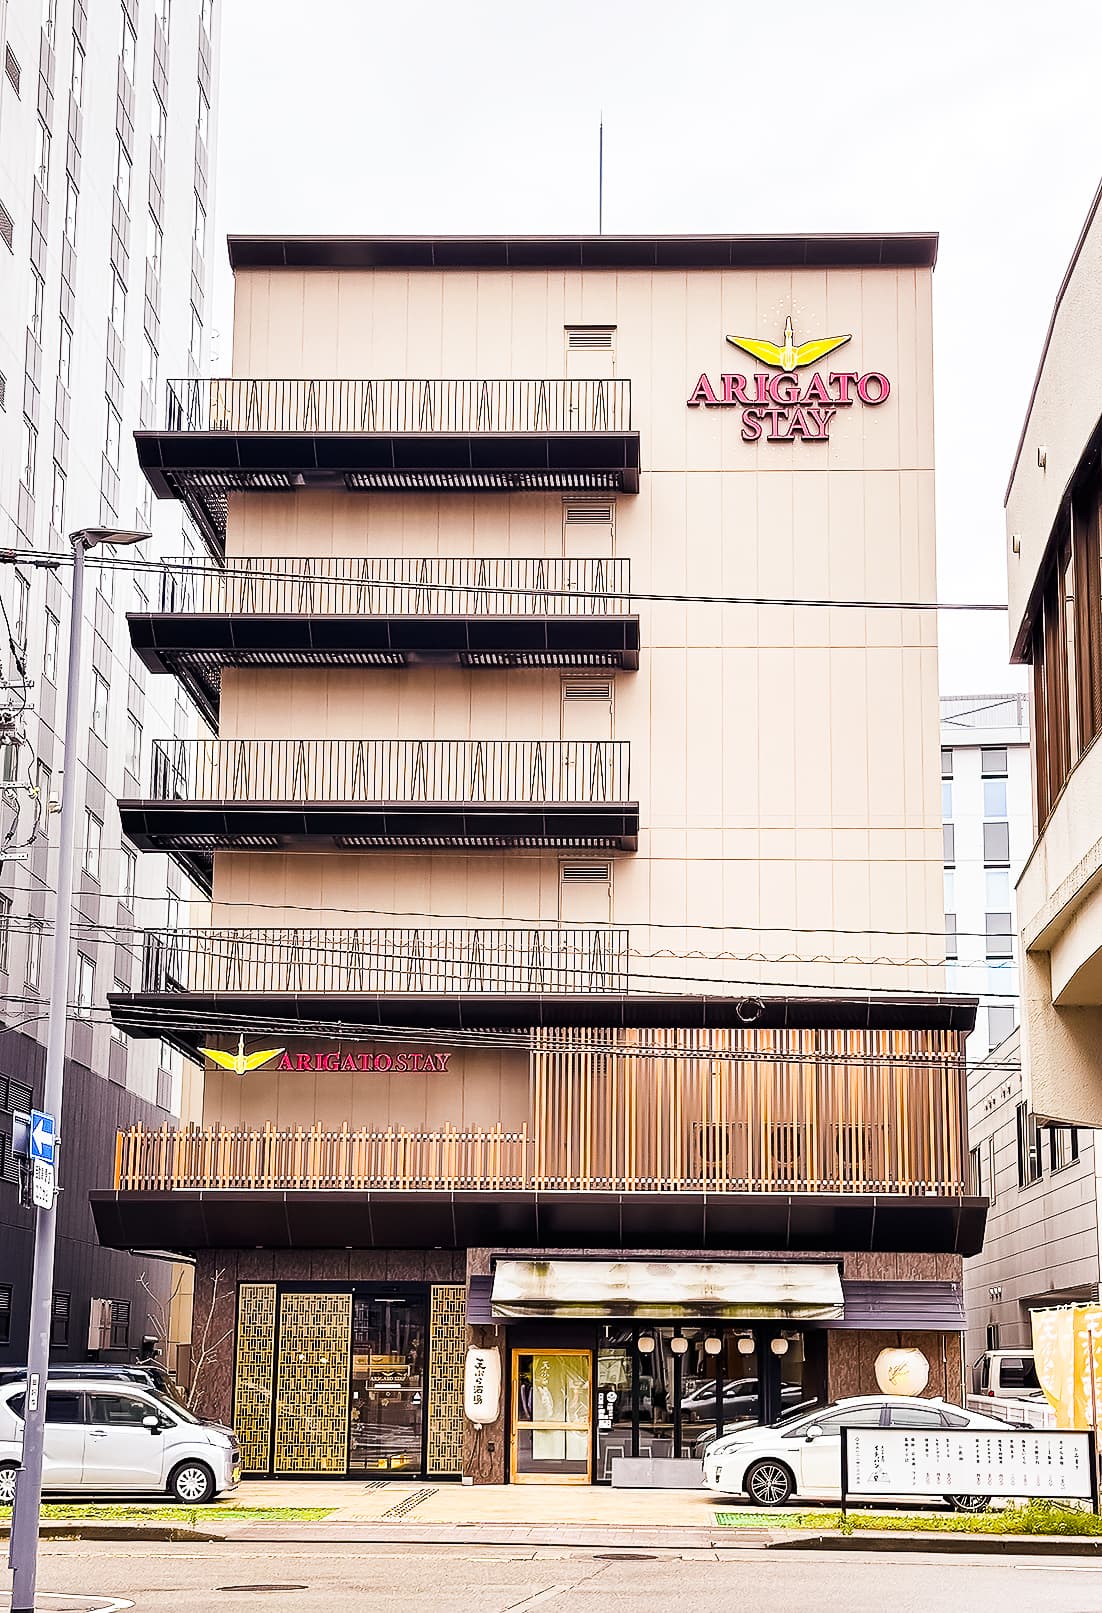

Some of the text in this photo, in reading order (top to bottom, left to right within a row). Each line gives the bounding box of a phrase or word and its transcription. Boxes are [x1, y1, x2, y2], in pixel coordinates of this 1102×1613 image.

[687, 372, 890, 406] ARIGATO
[741, 407, 836, 442] STAY
[277, 1051, 452, 1072] ARIGATO STAY
